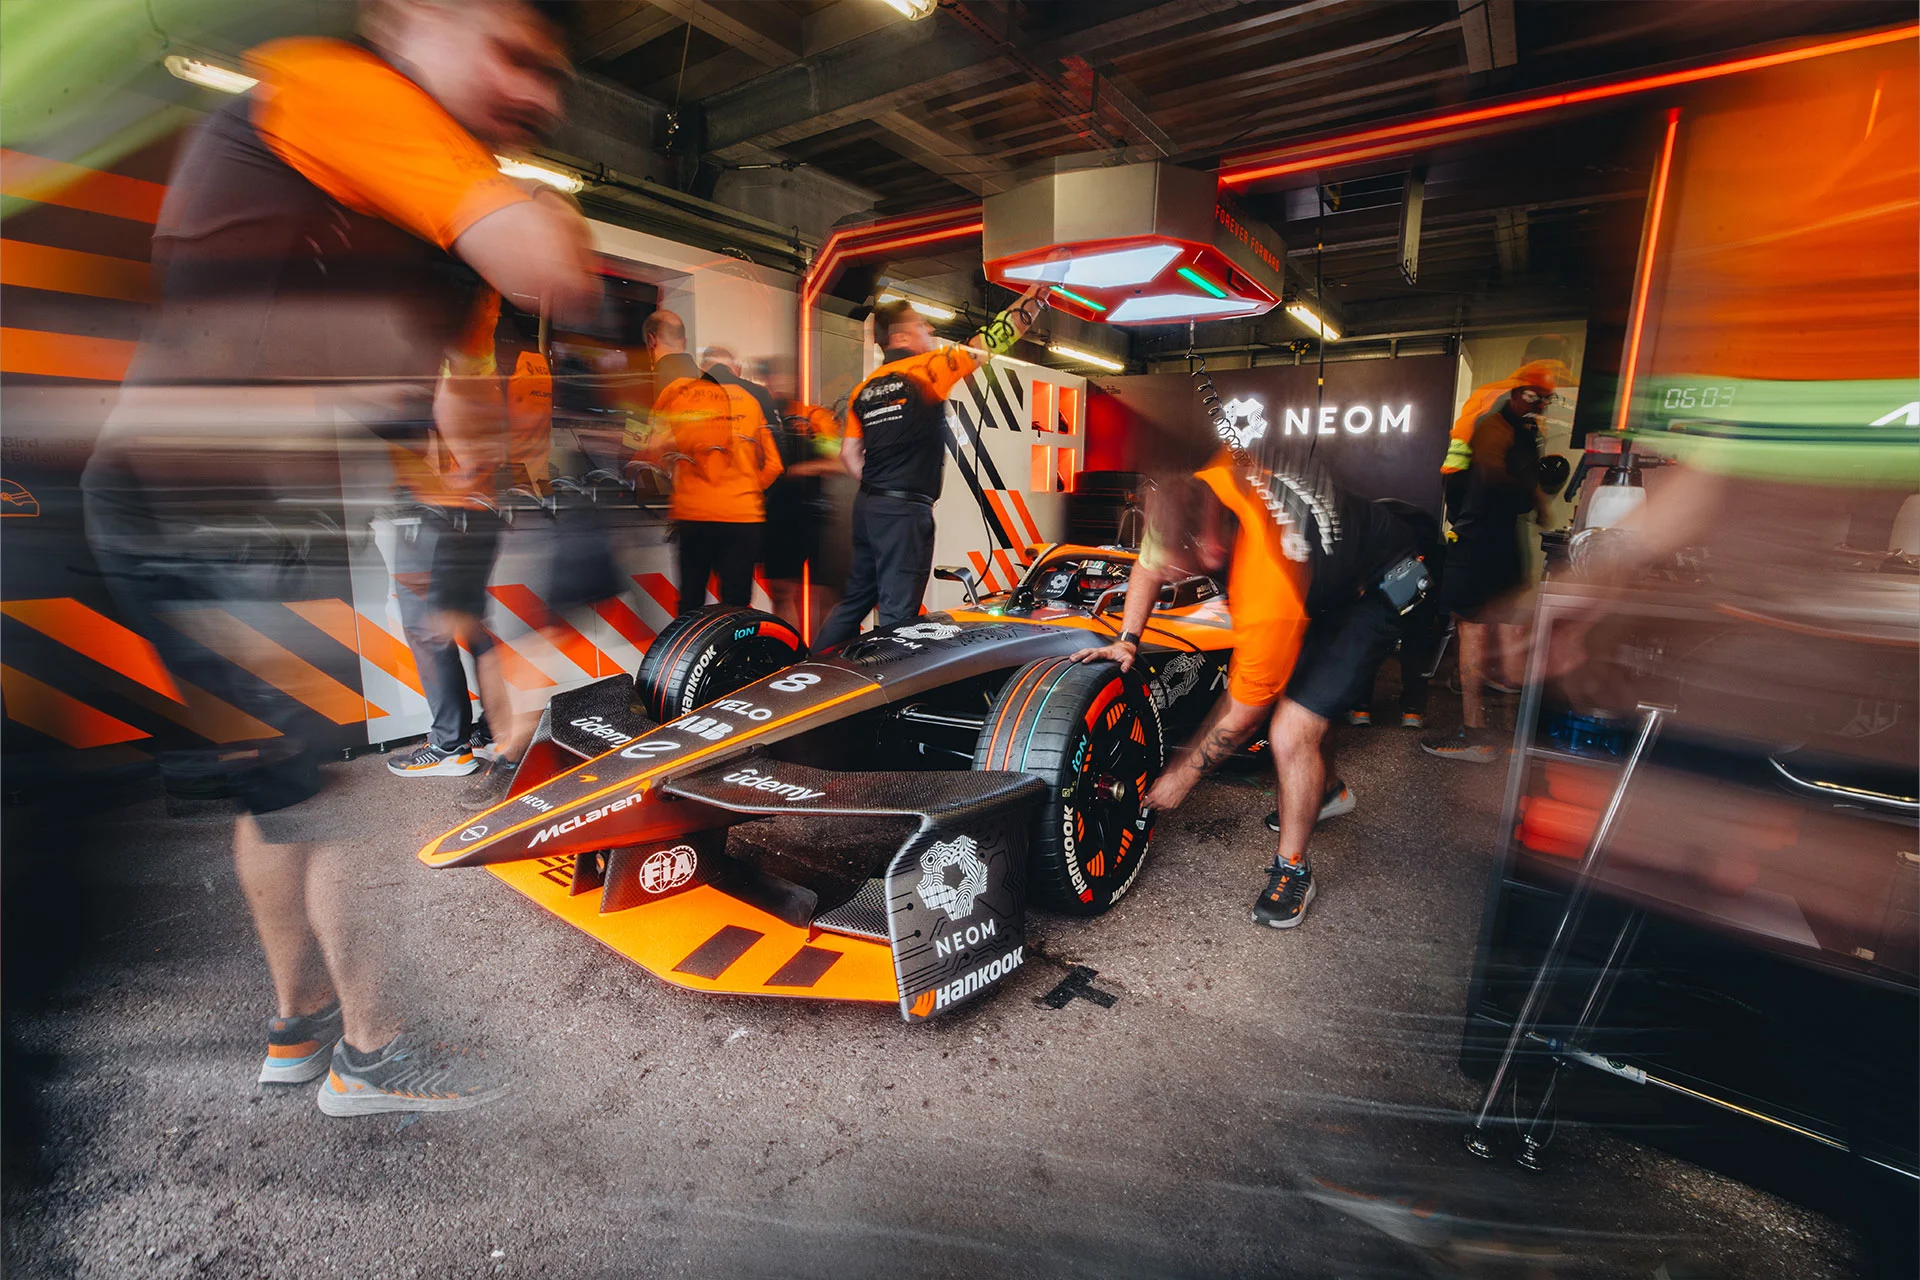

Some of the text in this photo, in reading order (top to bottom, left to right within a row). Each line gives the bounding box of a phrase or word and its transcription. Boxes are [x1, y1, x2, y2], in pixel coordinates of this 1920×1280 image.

[1215, 204, 1280, 273] FOREVER FORWARD
[1284, 404, 1412, 435] NEOM
[769, 673, 822, 692] 8
[712, 699, 773, 721] VELO
[666, 715, 733, 740] ABB
[518, 794, 554, 813] NEOM
[527, 793, 643, 849] McLaren
[935, 918, 996, 958] NEOM
